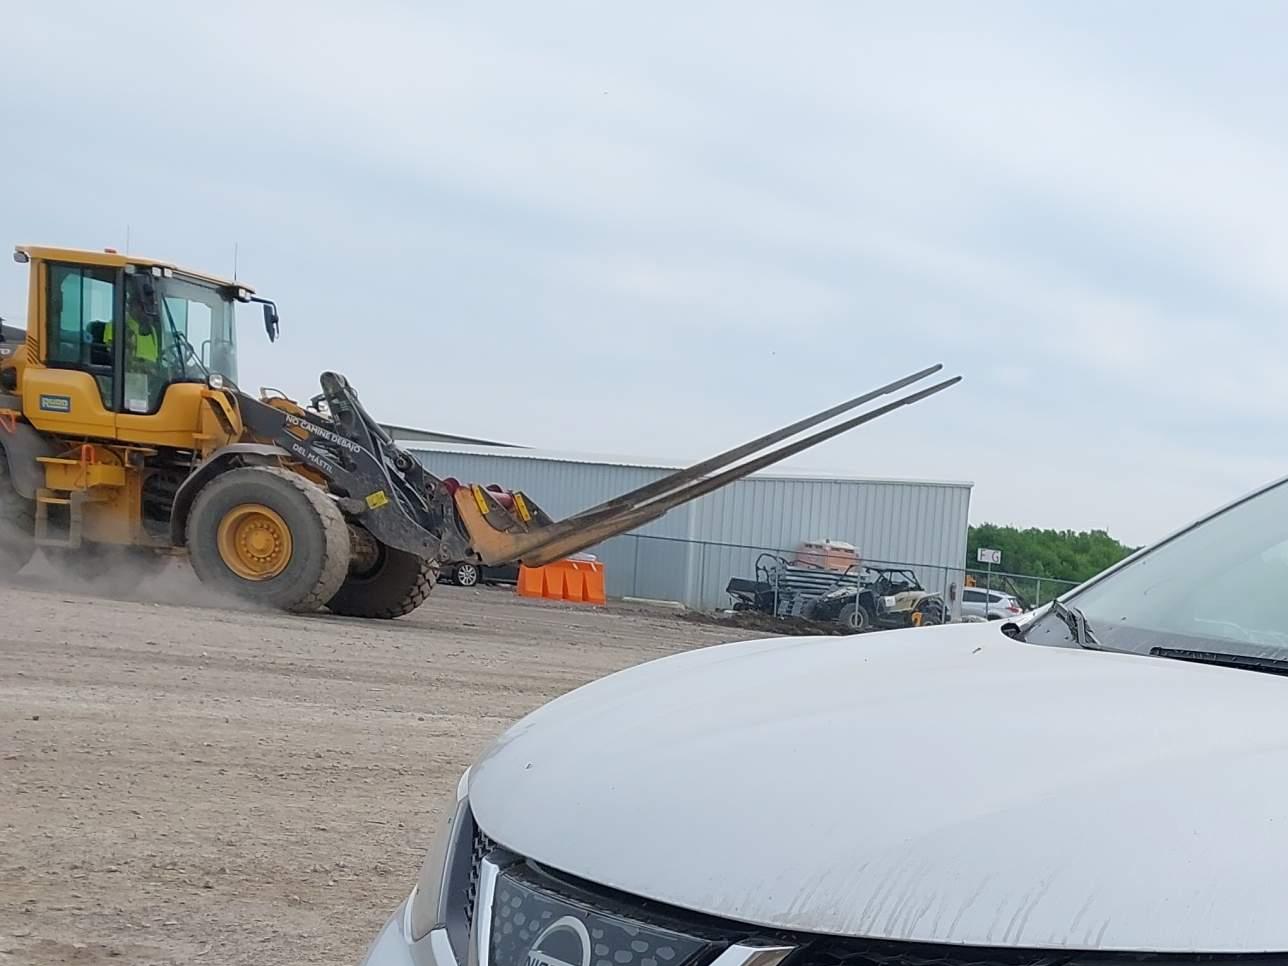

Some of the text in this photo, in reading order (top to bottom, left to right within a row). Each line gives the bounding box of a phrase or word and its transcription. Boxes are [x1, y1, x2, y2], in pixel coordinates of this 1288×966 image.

[285, 414, 361, 454] NO CAMINE DEBAJO
[292, 443, 333, 474] DEL MÁSTIL
